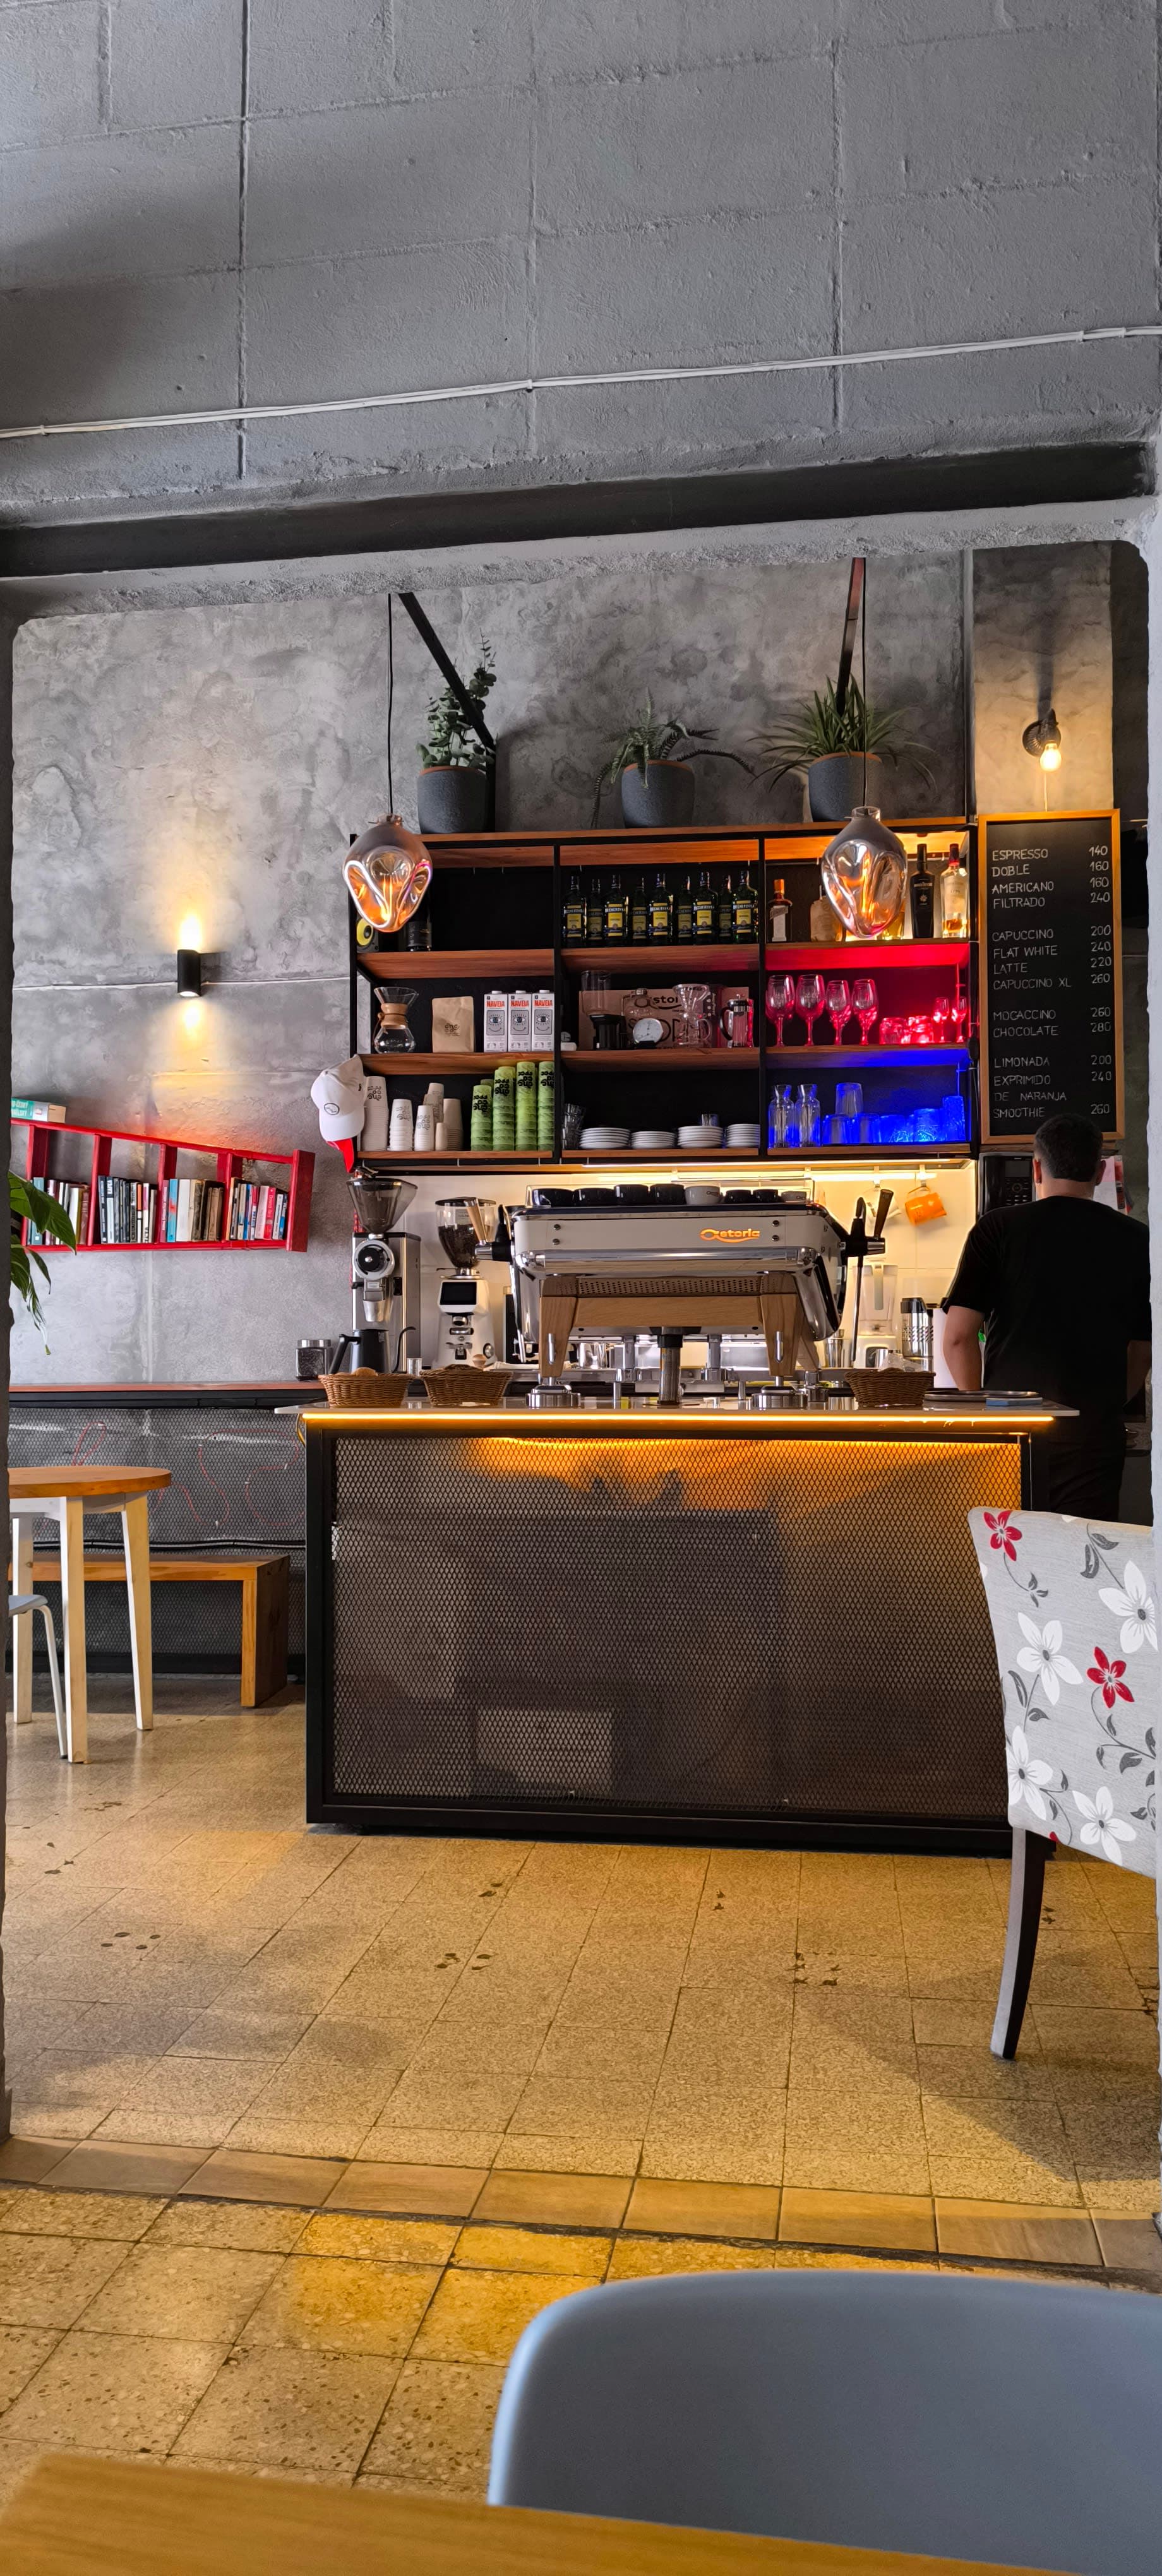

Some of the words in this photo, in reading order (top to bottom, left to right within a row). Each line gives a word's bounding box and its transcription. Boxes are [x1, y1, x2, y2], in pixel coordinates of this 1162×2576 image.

[993, 849, 1048, 861] ESPRESSO
[1089, 845, 1108, 856] 140
[991, 864, 1029, 877] DOBLE
[1090, 861, 1108, 871] 160
[992, 881, 1053, 894] AMERICANO
[1090, 877, 1109, 888] 160
[993, 897, 1045, 909] FILTRADO
[1091, 892, 1110, 903] 240
[992, 929, 1053, 941] CAPUCCINO
[1091, 925, 1111, 936] 200
[994, 947, 1019, 958] FLAT
[1024, 945, 1057, 956] WHITE
[1091, 941, 1111, 951] 240
[994, 963, 1027, 974] LATTE
[1091, 957, 1111, 967] 220
[993, 978, 1052, 989] CAPUCCINO
[1059, 978, 1071, 987] XL
[1091, 974, 1110, 984] 260
[993, 1010, 1056, 1020] MOCACCINO
[1091, 1007, 1110, 1017] 260
[993, 1025, 1058, 1037] CHOCOLATE
[1091, 1022, 1111, 1032] 280
[995, 1056, 1049, 1068] LIMONADA
[1091, 1055, 1111, 1064] 200
[994, 1075, 1050, 1086] EXPRIMIDO
[1091, 1071, 1111, 1081] 240
[995, 1092, 1009, 1101] DE
[1021, 1092, 1066, 1101] NARANJA
[994, 1107, 1045, 1118] SMOOTHIE
[1091, 1104, 1110, 1114] 260
